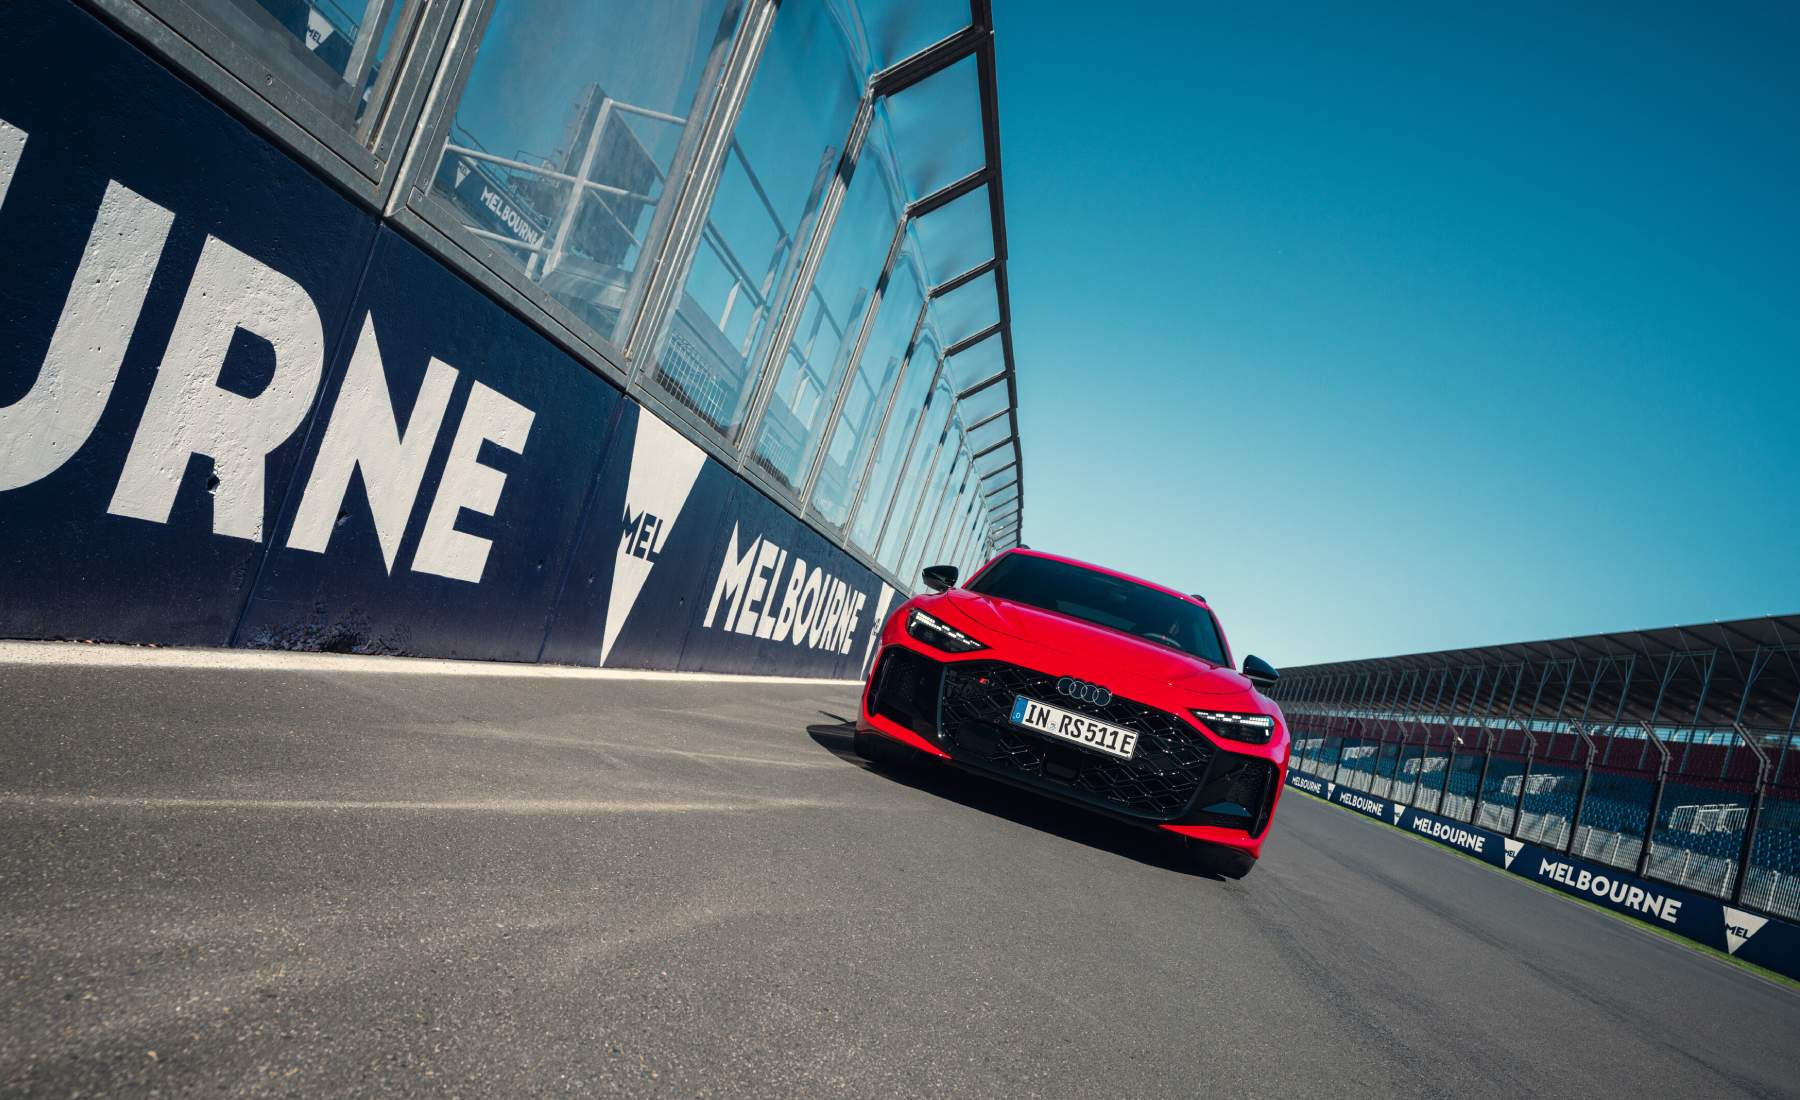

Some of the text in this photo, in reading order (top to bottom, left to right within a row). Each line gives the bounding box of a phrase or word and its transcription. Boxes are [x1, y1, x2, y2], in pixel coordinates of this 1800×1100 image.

[619, 503, 663, 565] MEL
[703, 520, 867, 655] MELBOURNE
[1025, 704, 1051, 728] IN
[1339, 791, 1384, 816] MELBOURNE
[1412, 815, 1486, 853] MELBOURNE
[1538, 857, 1683, 924] MELBOURNE
[1724, 922, 1750, 941] MEL
